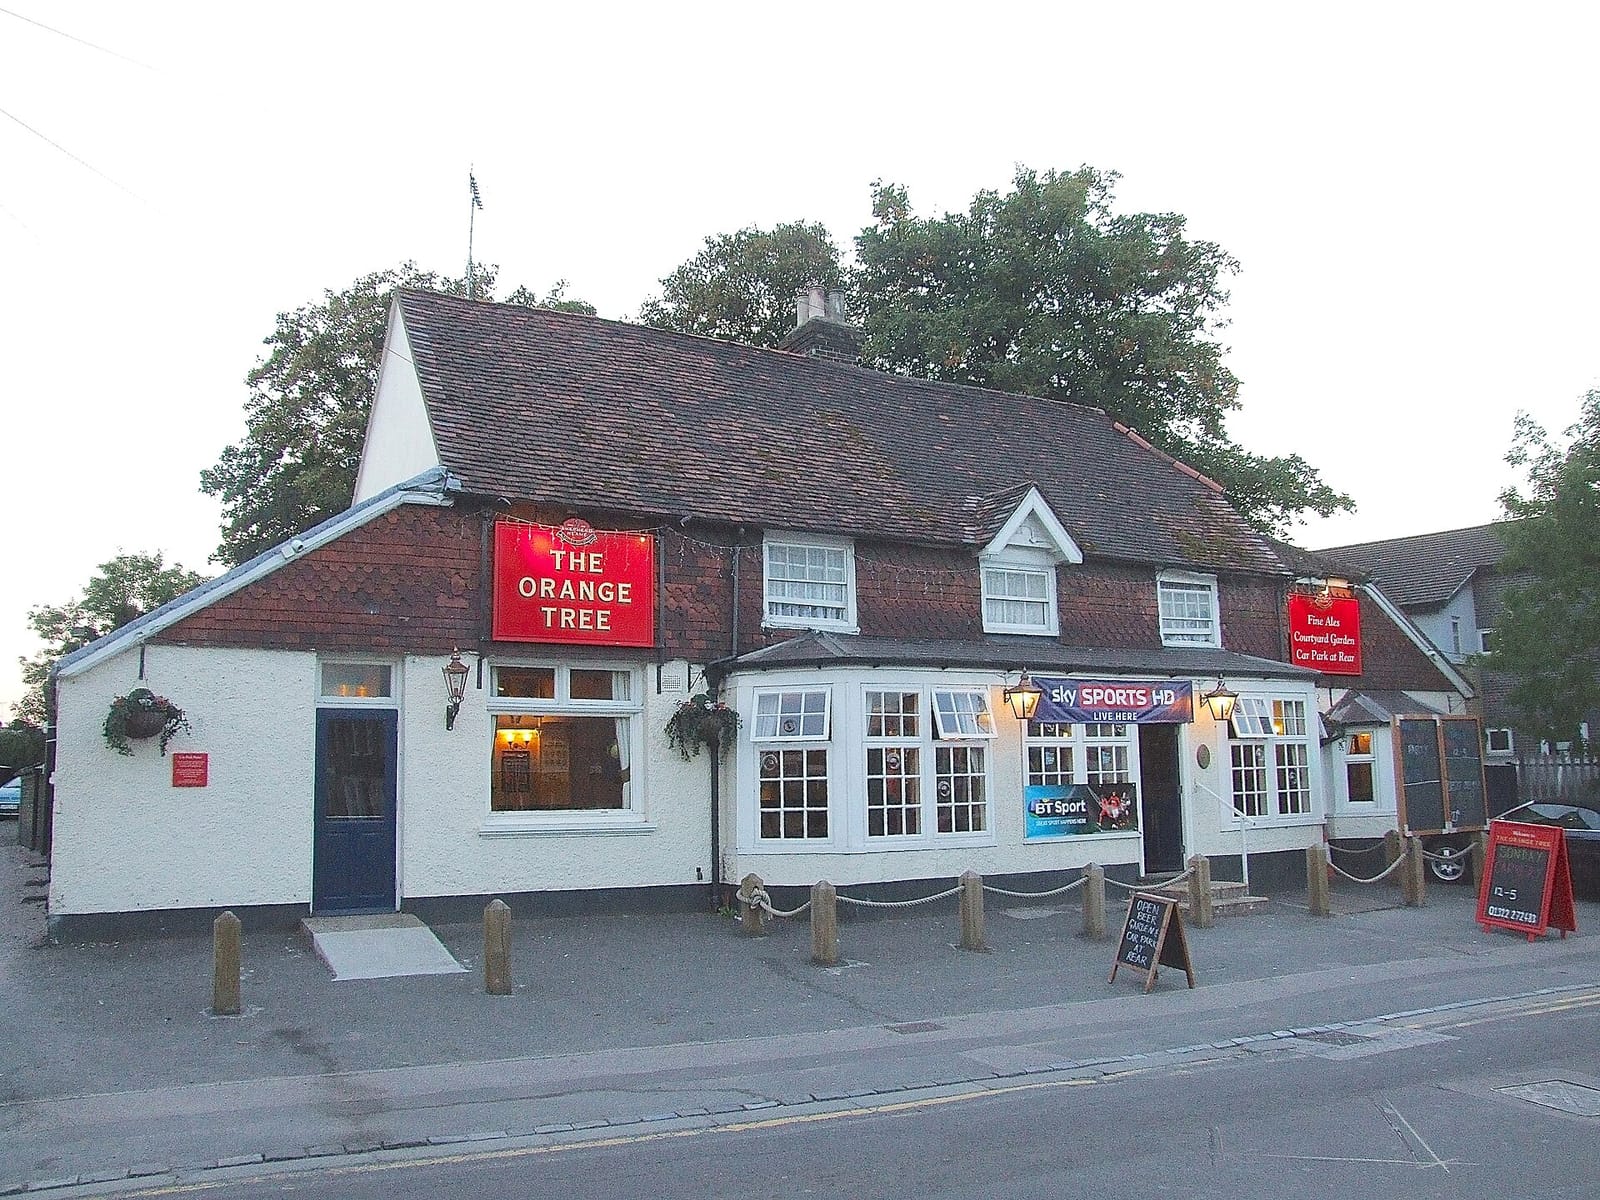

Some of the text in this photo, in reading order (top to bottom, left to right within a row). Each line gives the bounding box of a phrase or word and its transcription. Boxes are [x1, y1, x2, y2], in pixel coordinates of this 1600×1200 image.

[549, 549, 604, 573] THE
[518, 576, 632, 603] ORANGE
[541, 606, 611, 630] TREE
[1307, 614, 1340, 627] Fine Ales
[1294, 631, 1355, 646] Courtyard Garden
[1296, 649, 1355, 662] Car Park at Rear
[1052, 685, 1175, 706] sky SPORTS HD
[1093, 712, 1137, 721] LIVE HERE
[1035, 799, 1087, 815] BT Sport
[1494, 886, 1517, 900] 12-5
[1137, 900, 1160, 914] OPEN
[1137, 911, 1156, 925] BEER
[1126, 931, 1157, 948] CAR PARK
[1134, 943, 1143, 953] AT
[1126, 951, 1147, 965] REAR
